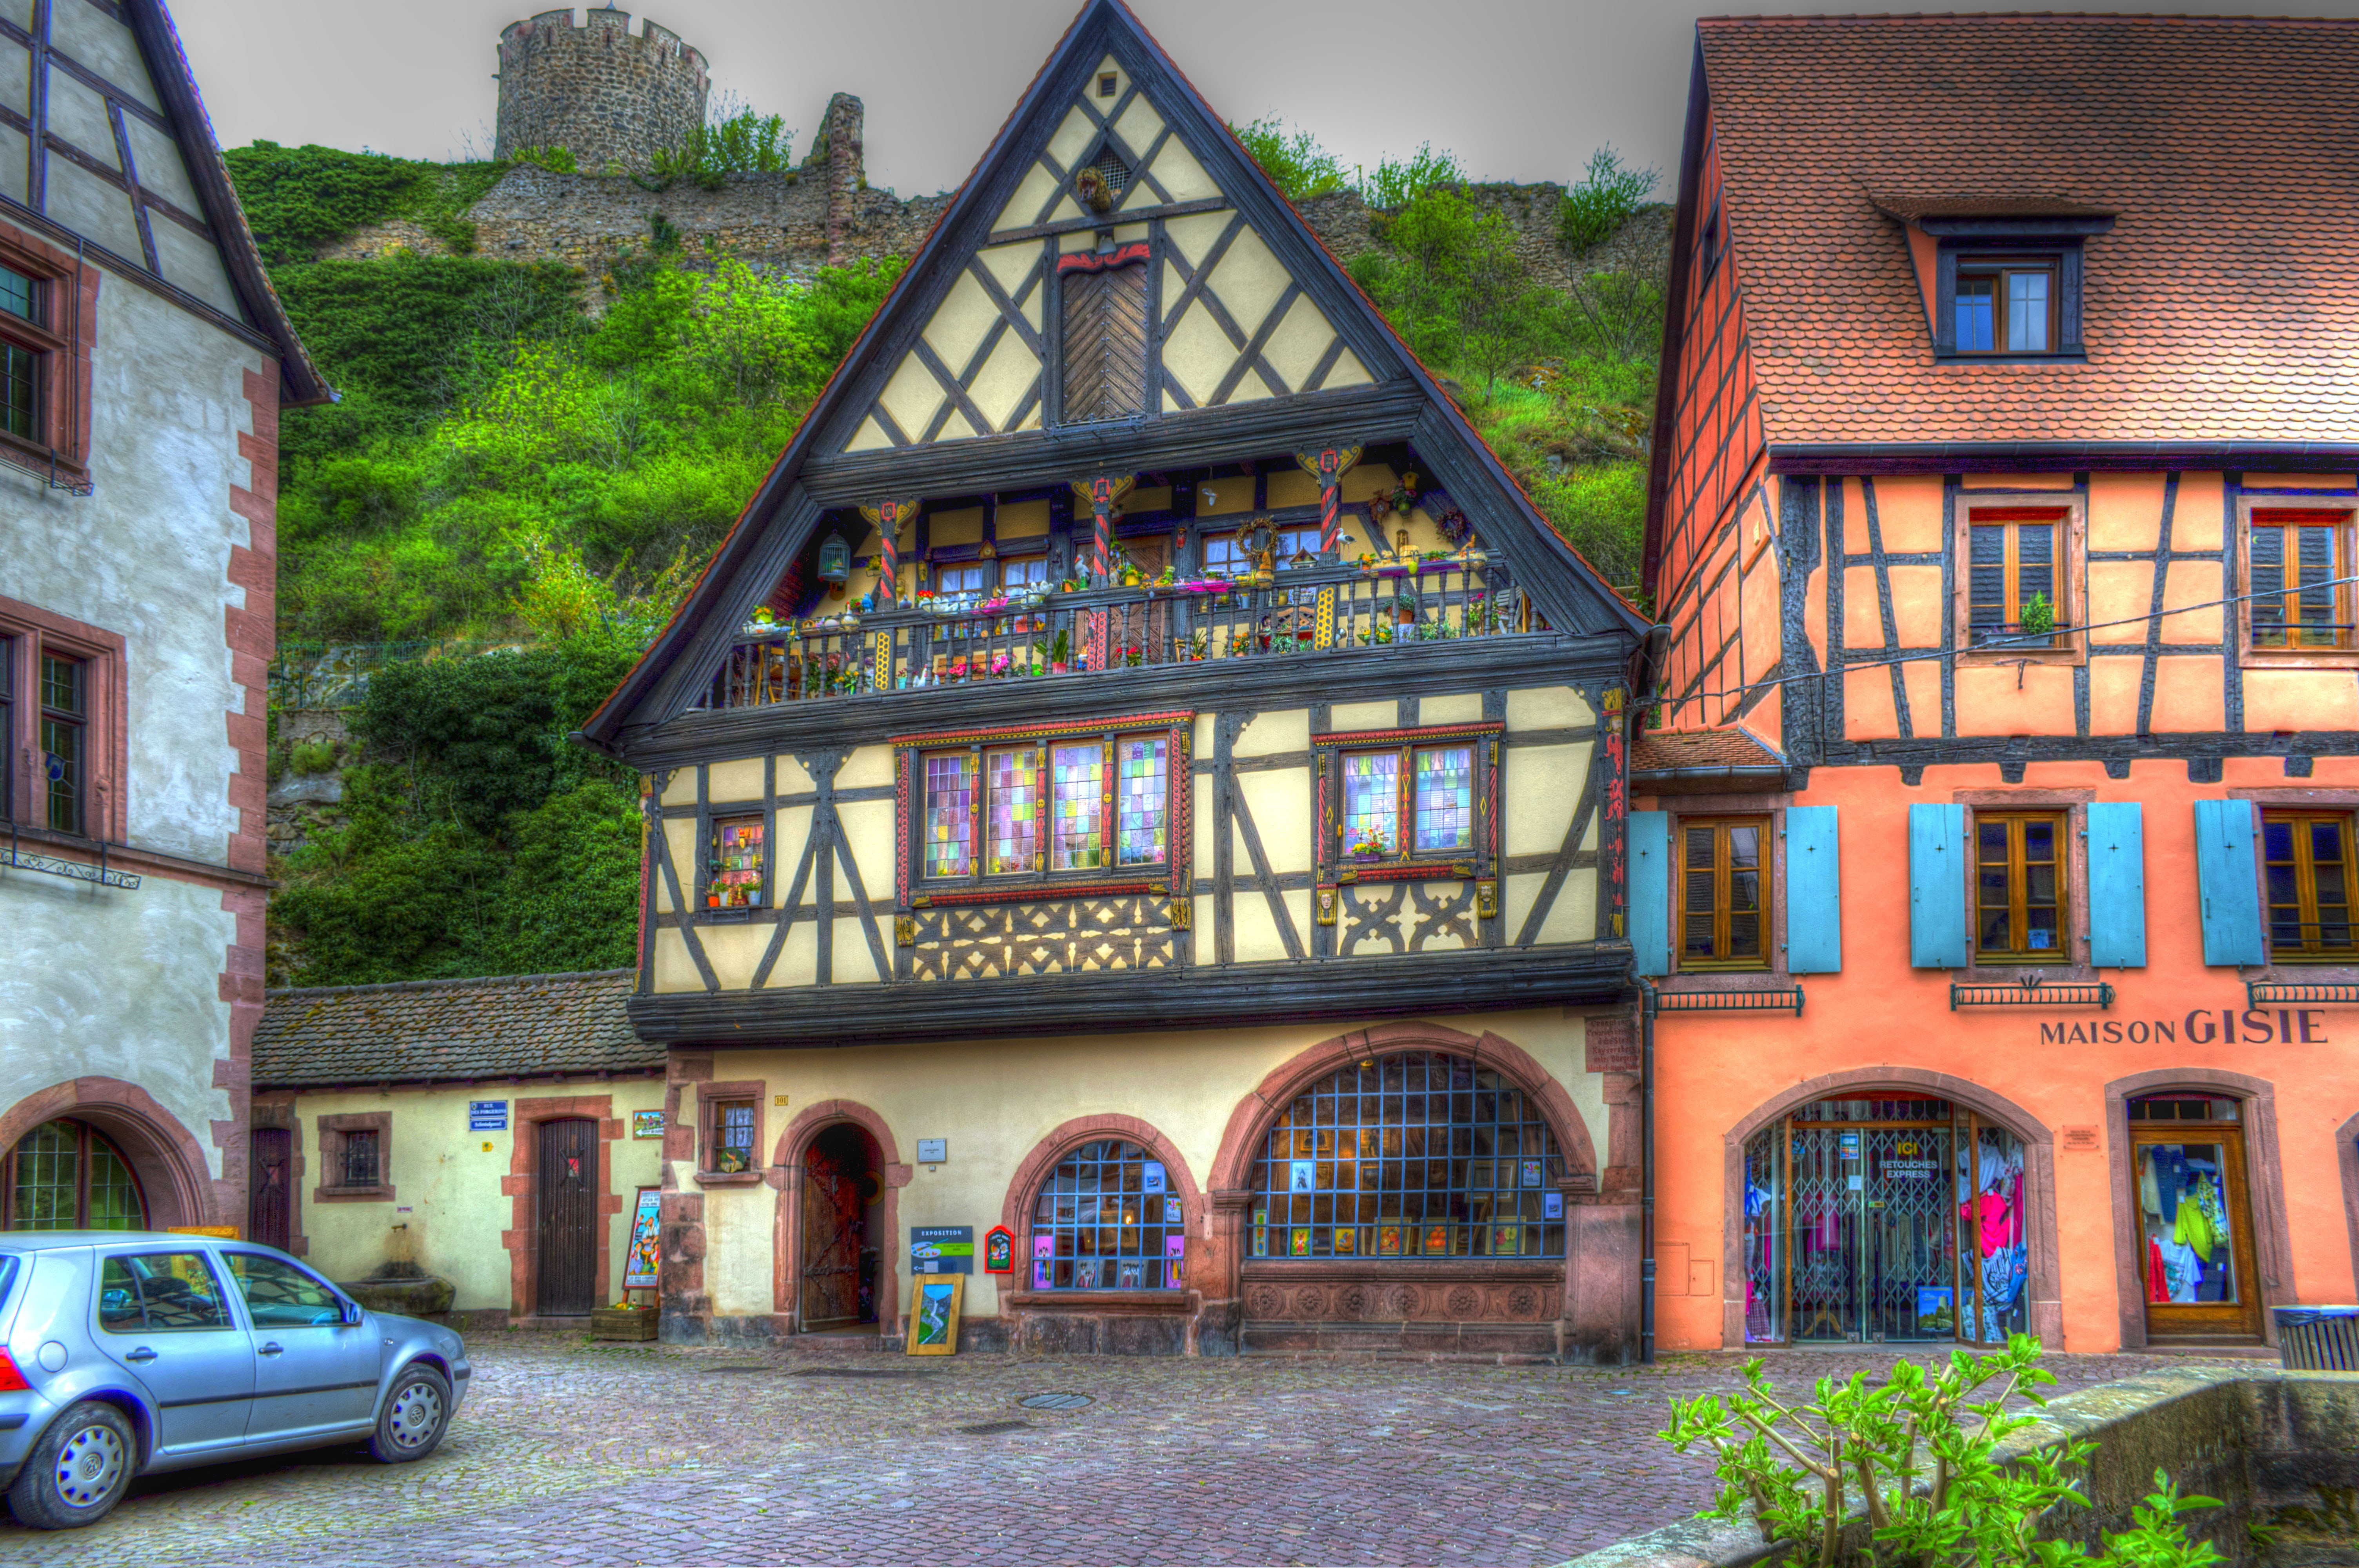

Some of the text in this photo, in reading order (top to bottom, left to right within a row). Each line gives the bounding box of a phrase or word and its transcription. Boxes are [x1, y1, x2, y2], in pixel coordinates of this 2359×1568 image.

[2040, 1009, 2329, 1045] MAISON GISIE
[1897, 1142, 1918, 1155] ICI
[1879, 1160, 1938, 1169] RETOUCHES
[1886, 1170, 1931, 1178] EXPRESS
